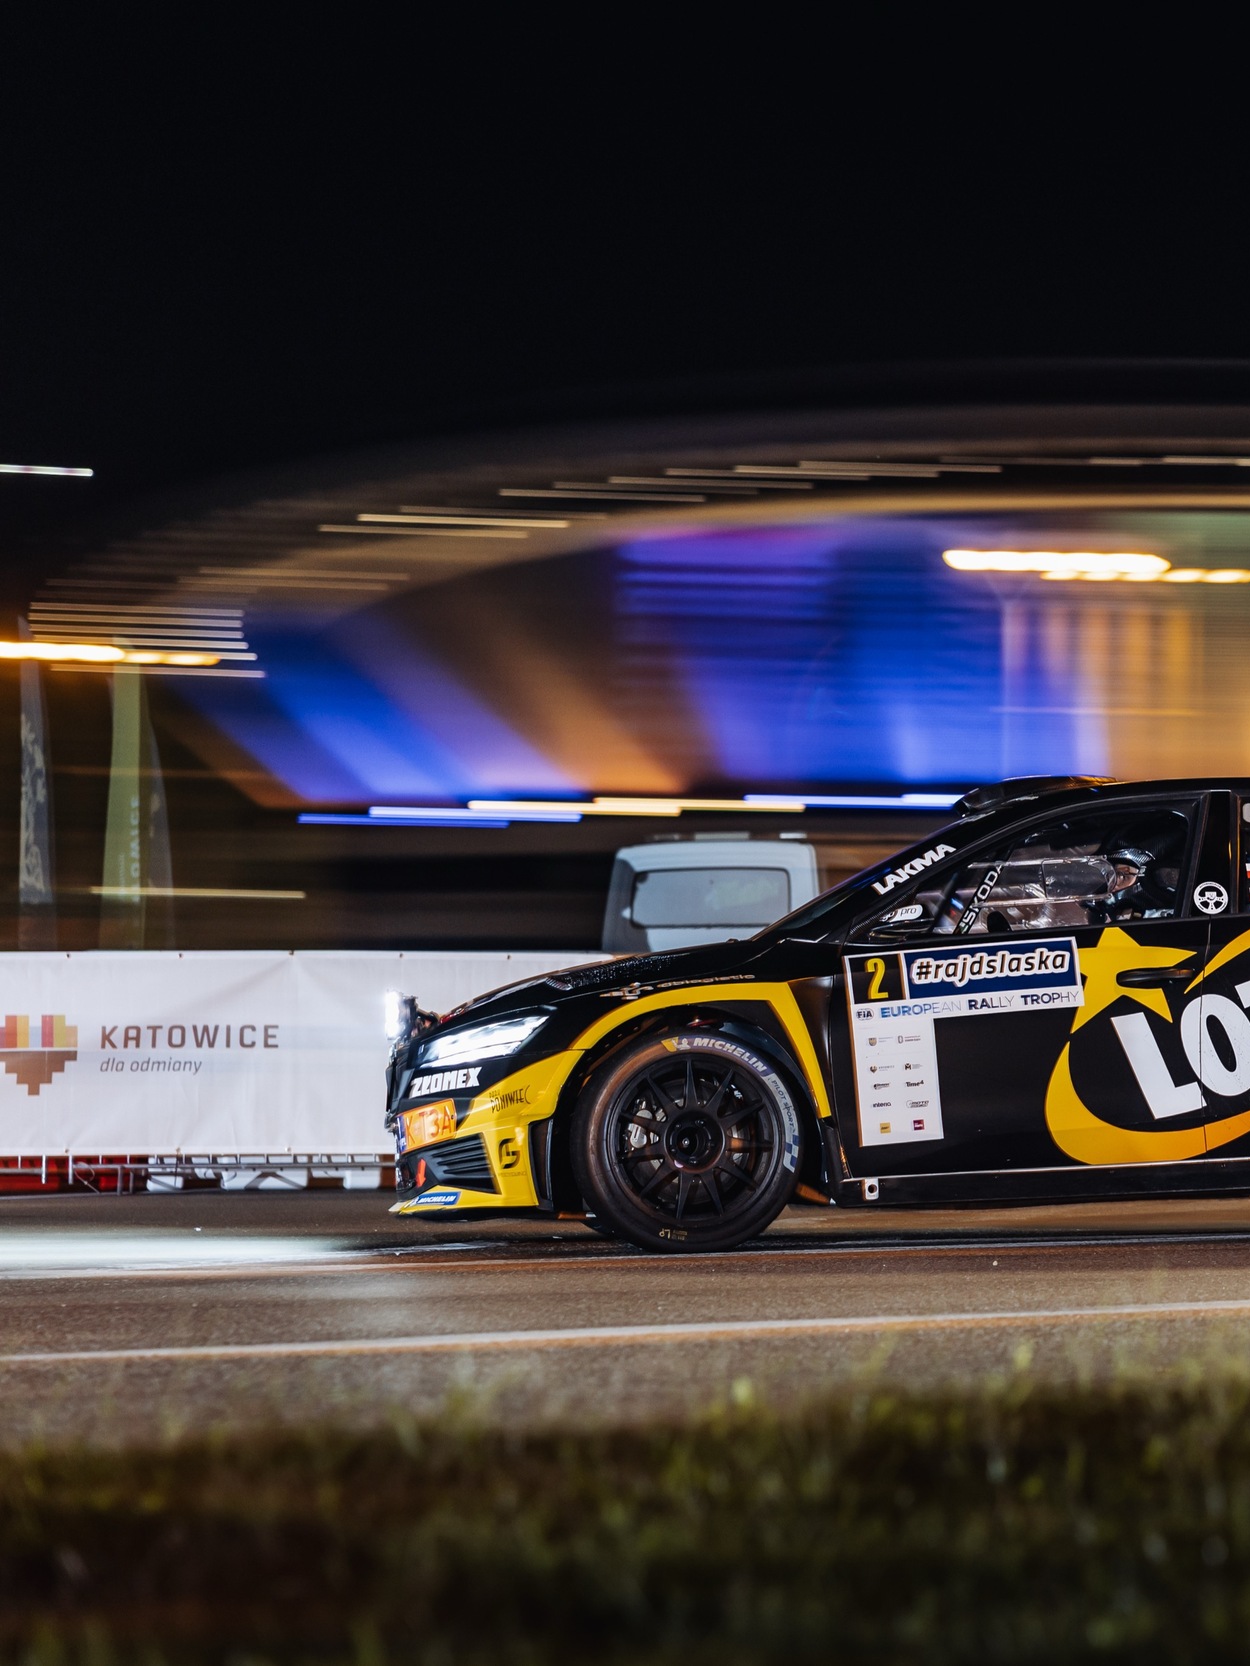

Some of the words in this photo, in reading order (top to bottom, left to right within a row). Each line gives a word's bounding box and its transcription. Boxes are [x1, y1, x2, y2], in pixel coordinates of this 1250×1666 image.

[871, 843, 957, 895] LAKMA
[864, 957, 889, 1000] 2
[915, 949, 1067, 983] #rajdslaska
[857, 1009, 873, 1019] FIA
[880, 1000, 962, 1018] EUROPEAN
[967, 994, 1014, 1011] RALLY
[1020, 990, 1080, 1006] TROPHY
[100, 1024, 279, 1049] KATOWICE
[100, 1057, 125, 1073] dla
[130, 1057, 202, 1075] odmiany
[693, 1037, 768, 1073] MICHELIN
[772, 1079, 786, 1101] PILOT
[783, 1100, 795, 1128] SPORT
